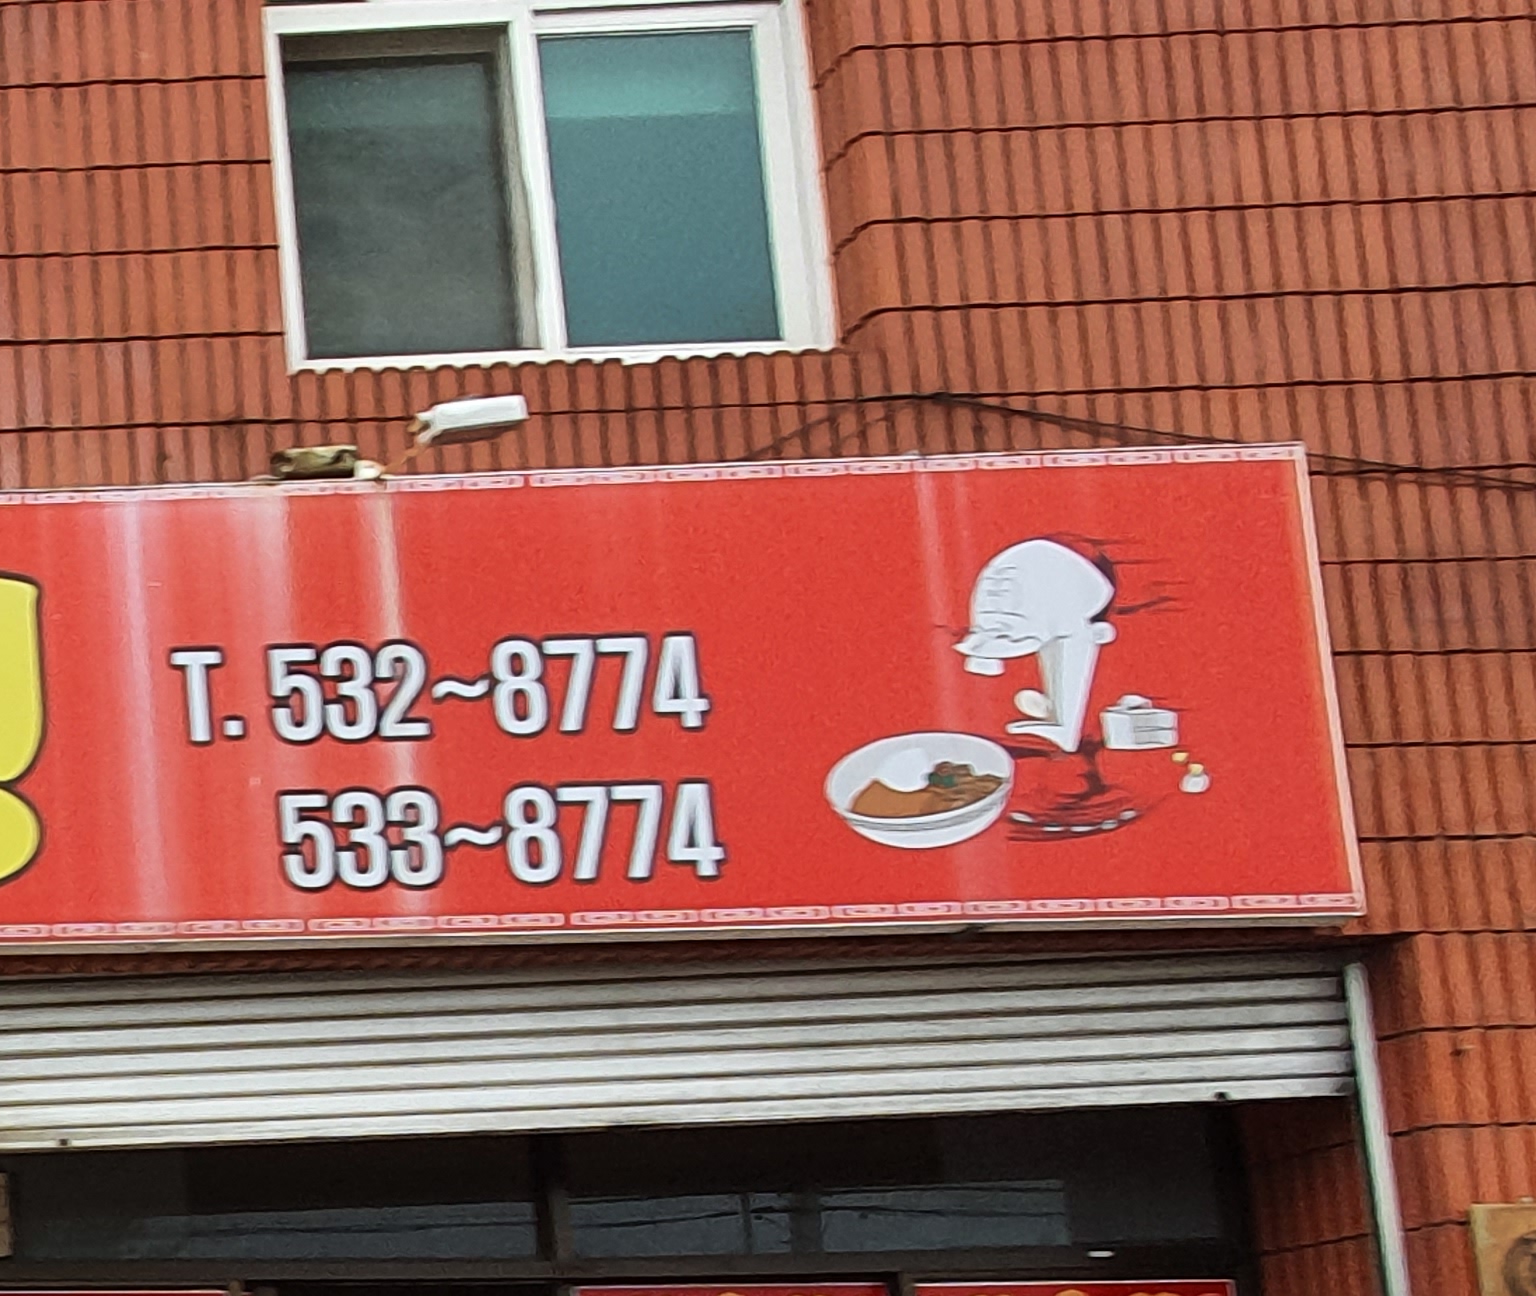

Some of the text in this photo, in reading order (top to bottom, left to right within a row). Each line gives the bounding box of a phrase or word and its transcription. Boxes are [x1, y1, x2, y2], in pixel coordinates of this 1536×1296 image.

[168, 633, 711, 743] T. 532~8774
[278, 780, 726, 889] 533~8774
